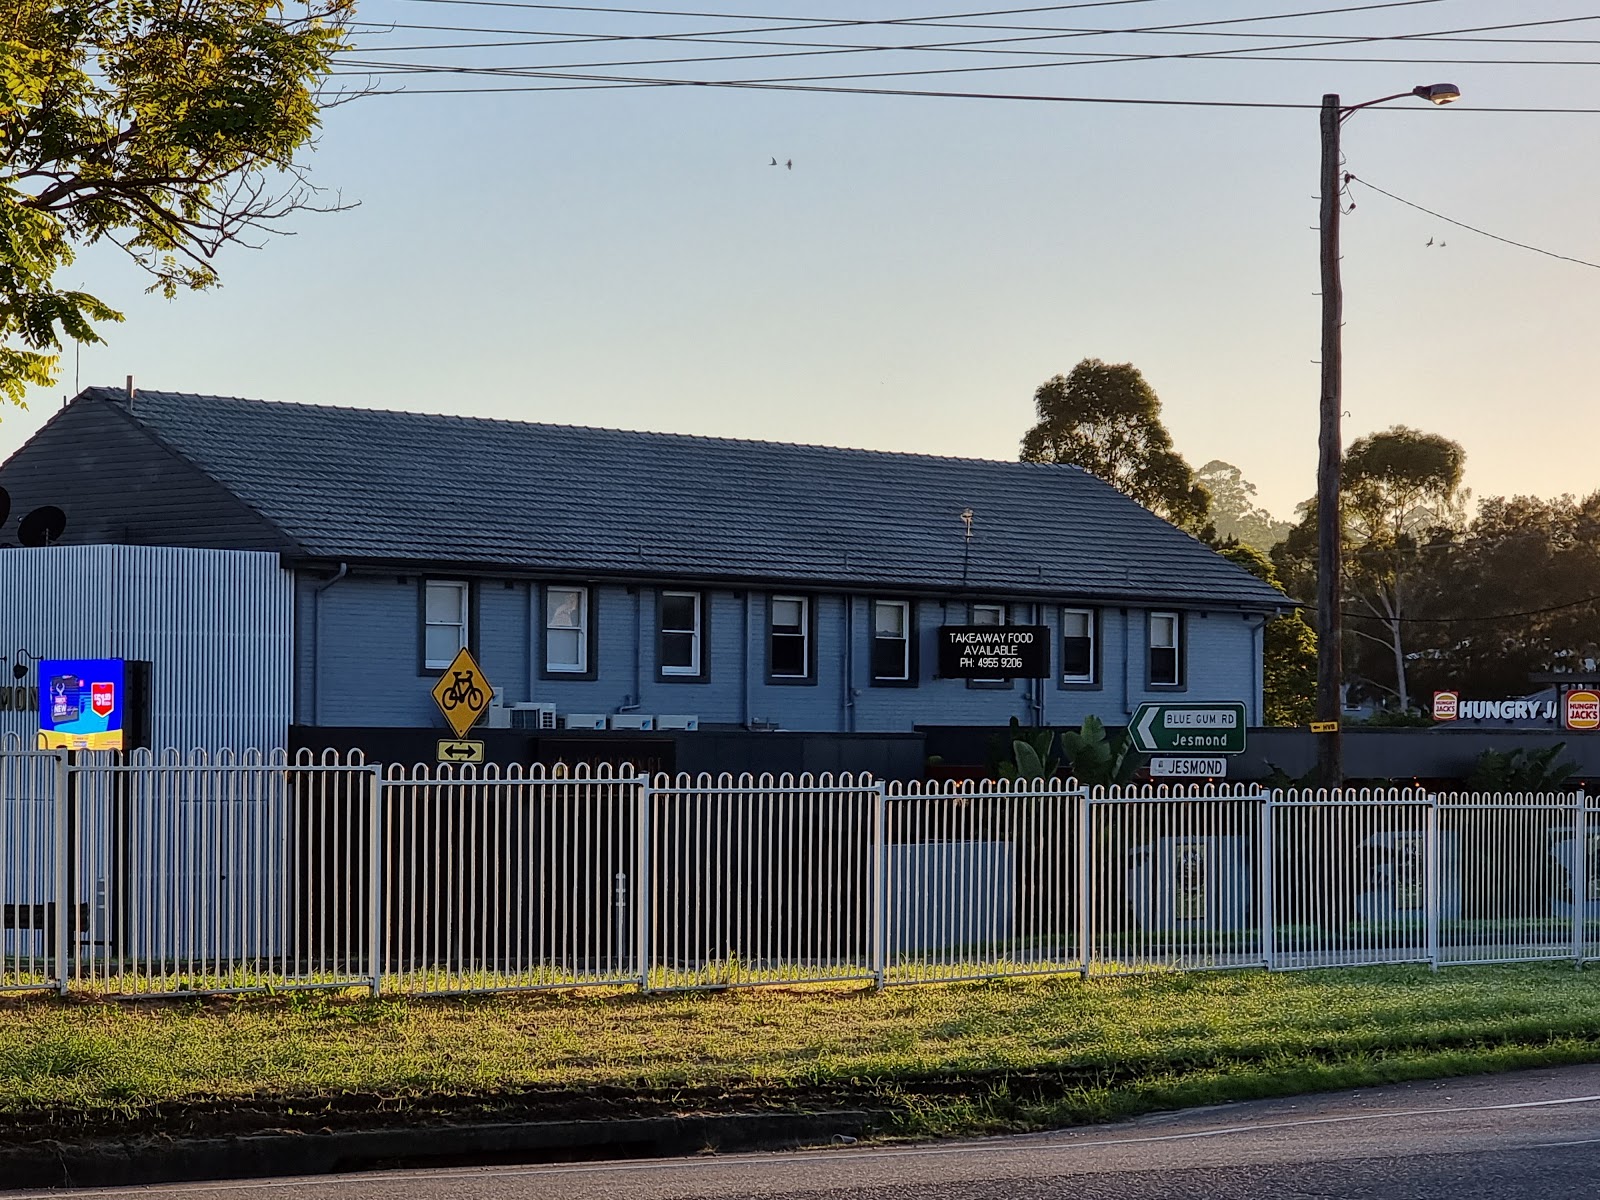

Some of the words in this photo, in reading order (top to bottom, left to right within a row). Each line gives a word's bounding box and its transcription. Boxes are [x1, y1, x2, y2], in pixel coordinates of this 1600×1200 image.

[949, 633, 1006, 643] TAKEAWAY
[1008, 633, 1034, 643] FOOD
[963, 645, 1018, 656] AVAILABLE
[960, 658, 975, 668] PH:
[977, 658, 999, 668] 4955
[1001, 658, 1023, 668] 9206
[1459, 700, 1541, 719] HUNGRY
[1167, 714, 1191, 724] BLUE
[1196, 714, 1216, 724] GUM
[1221, 714, 1234, 723] RD
[1172, 733, 1227, 746] Jesmond
[1168, 760, 1222, 775] JESMOND
